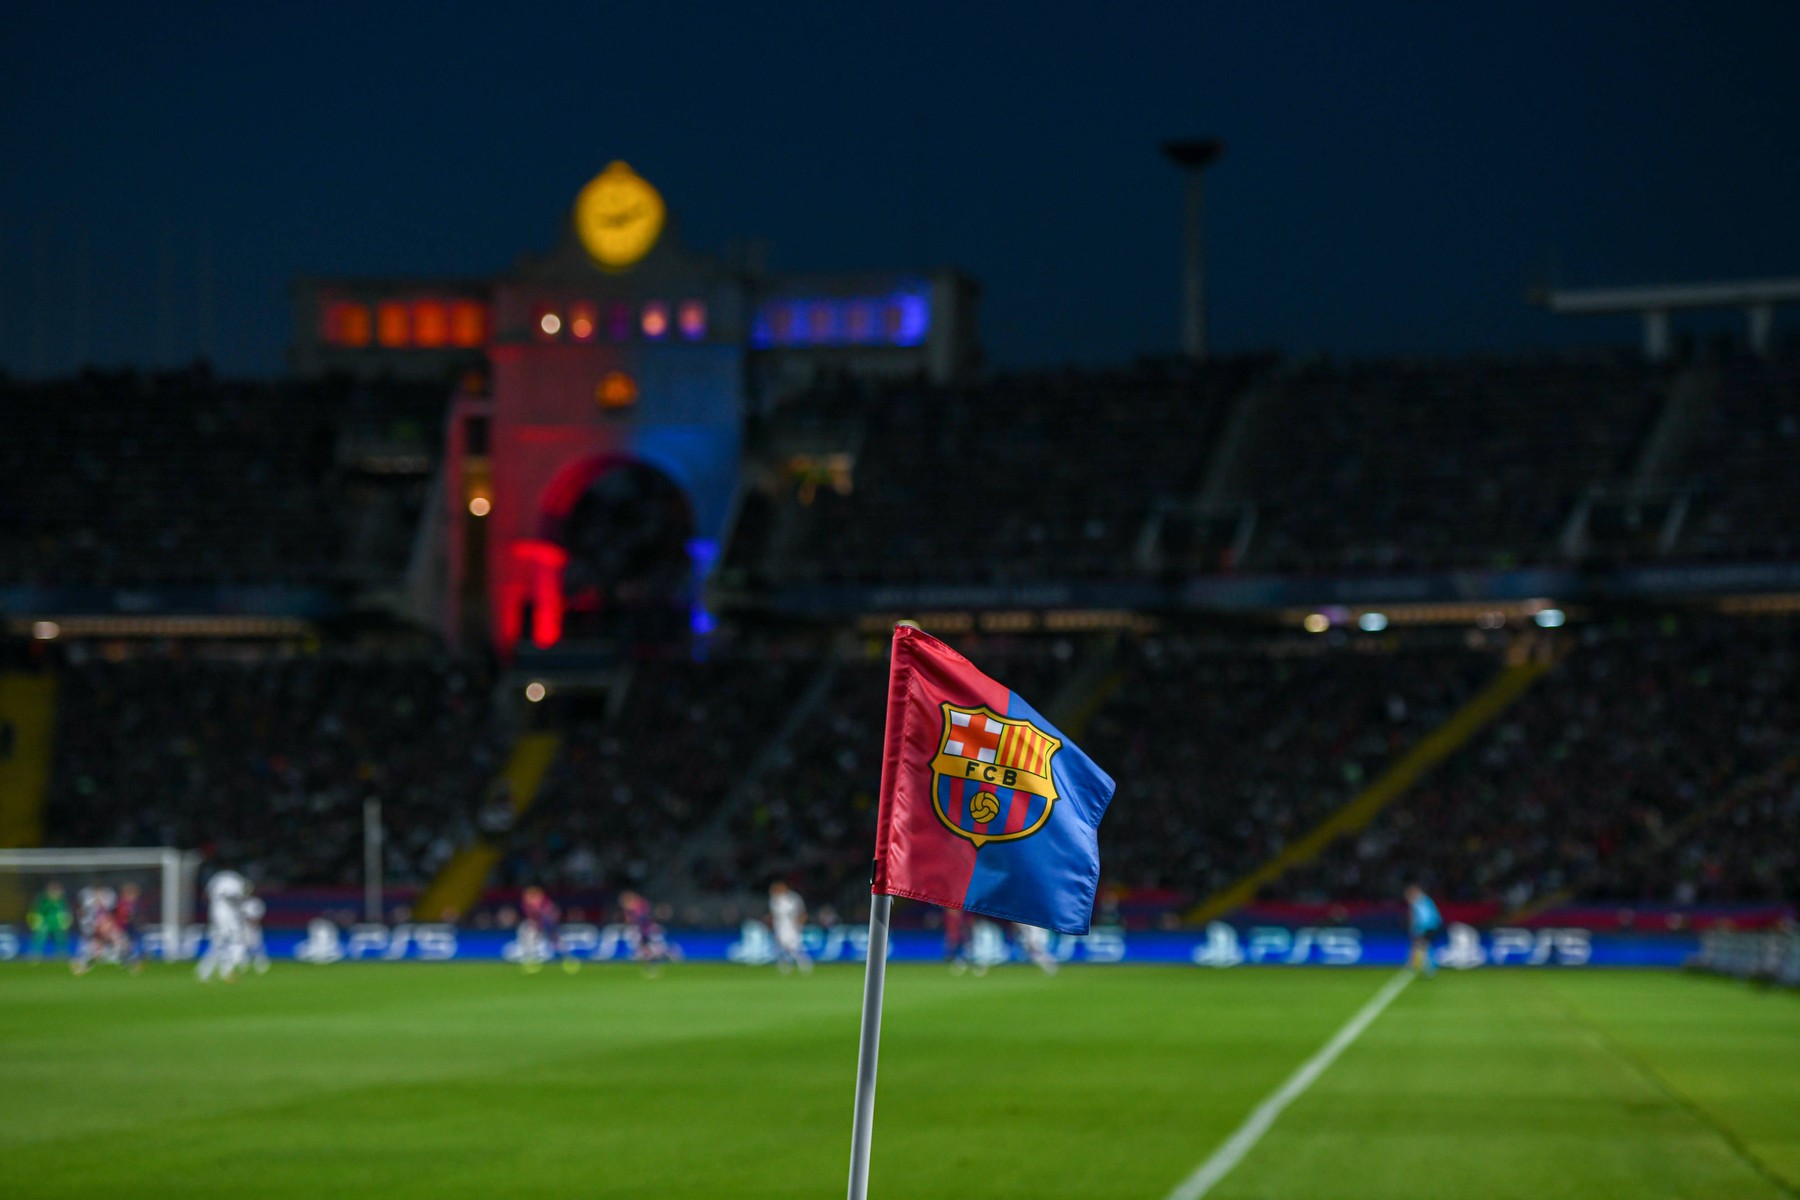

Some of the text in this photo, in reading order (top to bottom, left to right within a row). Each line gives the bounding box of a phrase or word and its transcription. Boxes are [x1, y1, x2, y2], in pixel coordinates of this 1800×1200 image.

[965, 761, 1017, 786] FCB
[348, 923, 458, 960] PS5
[1248, 926, 1363, 964] PS5
[1491, 927, 1592, 965] PS5
